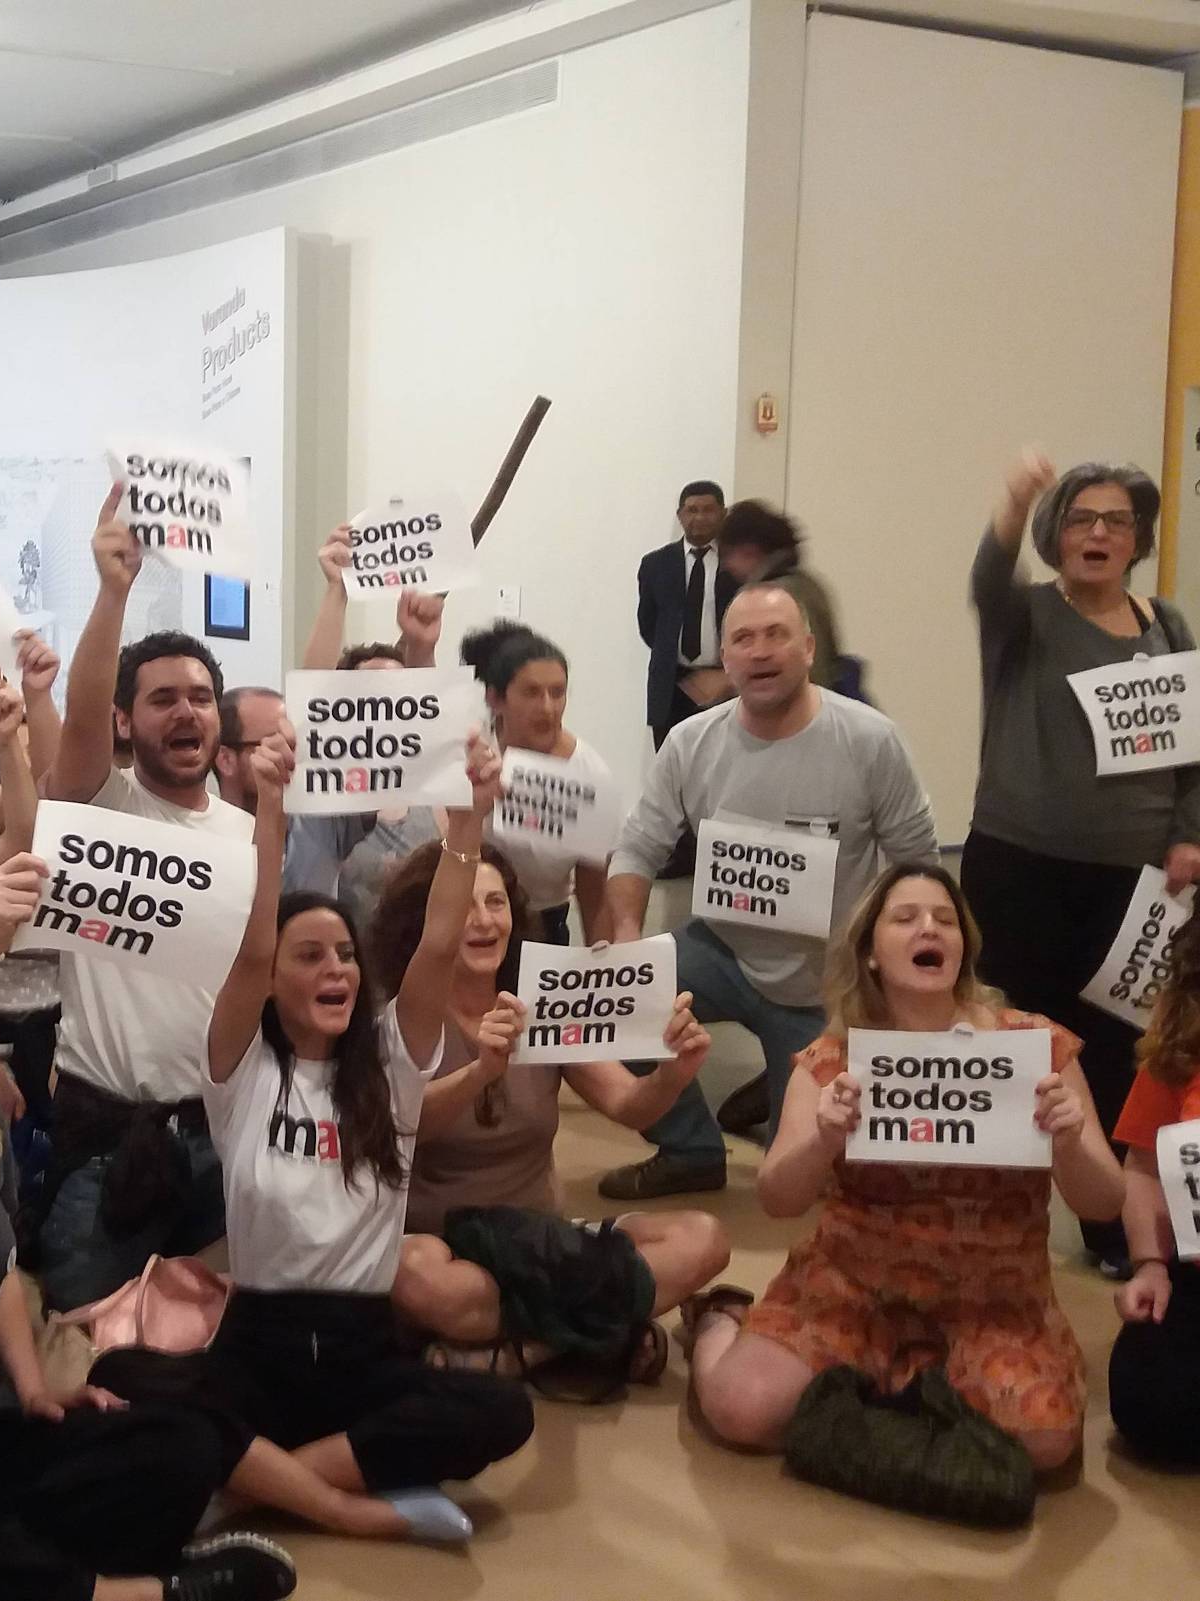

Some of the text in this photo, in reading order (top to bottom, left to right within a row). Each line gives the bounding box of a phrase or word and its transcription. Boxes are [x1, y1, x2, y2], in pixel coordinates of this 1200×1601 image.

[202, 310, 271, 384] Products
[126, 454, 231, 494] somos
[127, 484, 222, 523] todos
[128, 525, 212, 555] mam
[349, 513, 441, 548] somos
[351, 541, 433, 571] todos
[356, 566, 427, 588] mam
[1095, 673, 1186, 703] somos
[307, 694, 440, 722] somos
[1104, 701, 1180, 731] todos
[305, 725, 421, 759] todos
[1110, 729, 1175, 757] mam
[306, 765, 403, 794] mam
[59, 833, 212, 891] somos
[711, 840, 806, 871] somos
[710, 860, 789, 894] todos
[50, 870, 184, 927] todos
[707, 888, 777, 916] mam
[33, 905, 154, 956] mam
[1109, 900, 1165, 1000] somos
[538, 962, 654, 991] somos
[534, 992, 635, 1019] todos
[528, 1021, 616, 1048] mam
[871, 1055, 1014, 1079] somos
[869, 1083, 992, 1112] todos
[269, 1115, 341, 1161] ma
[869, 1116, 975, 1144] mam
